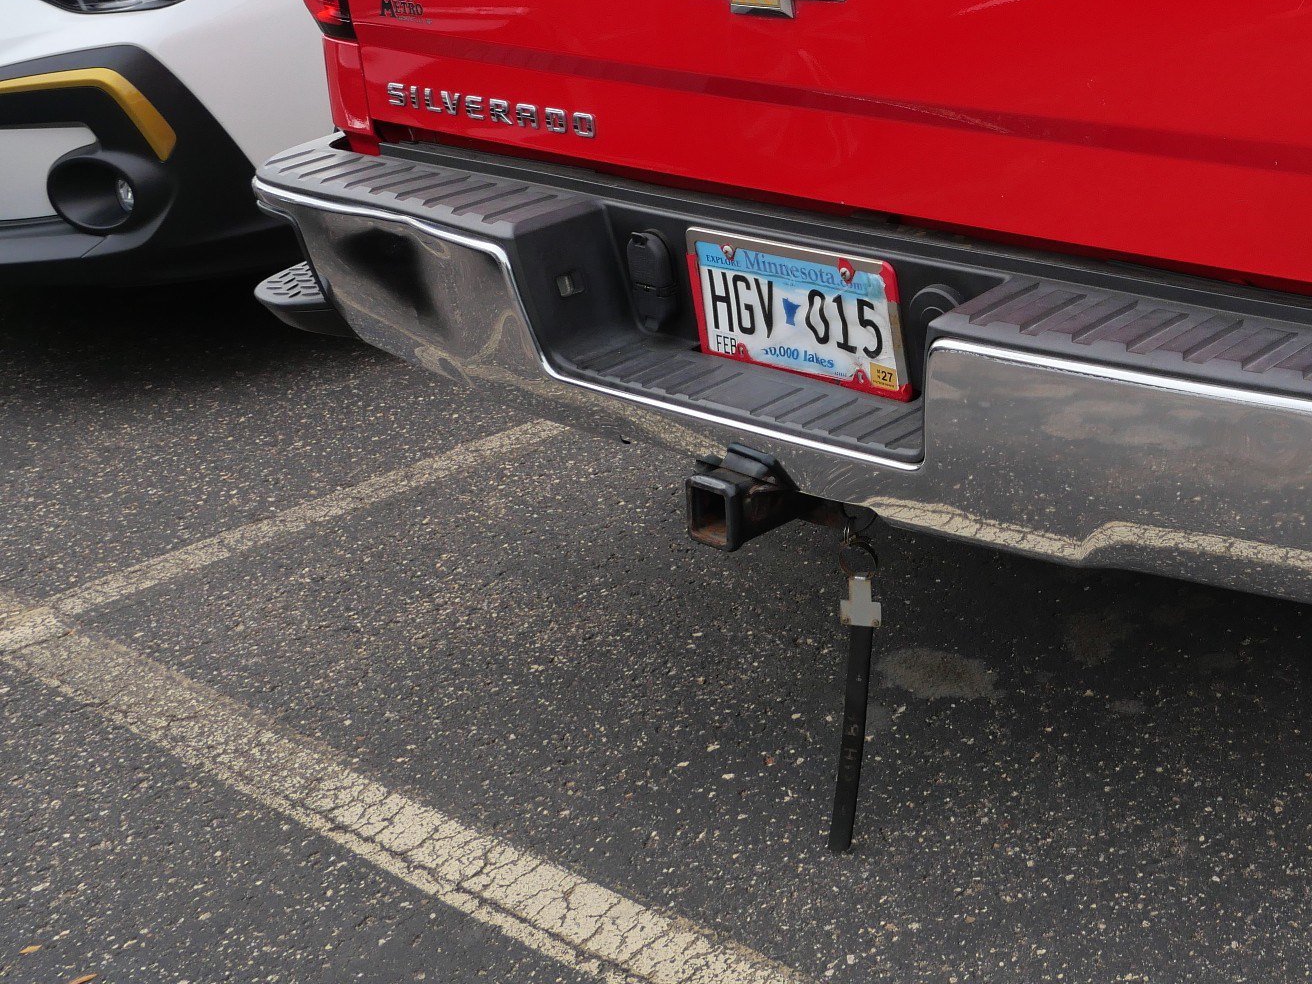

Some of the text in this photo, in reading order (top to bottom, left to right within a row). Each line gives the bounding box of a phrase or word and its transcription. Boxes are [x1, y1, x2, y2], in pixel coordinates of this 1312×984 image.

[387, 82, 597, 139] SILVERADO
[707, 269, 883, 359] HGV 015
[716, 334, 737, 355] FEB
[803, 349, 835, 368] lakes
[881, 370, 893, 383] 27
